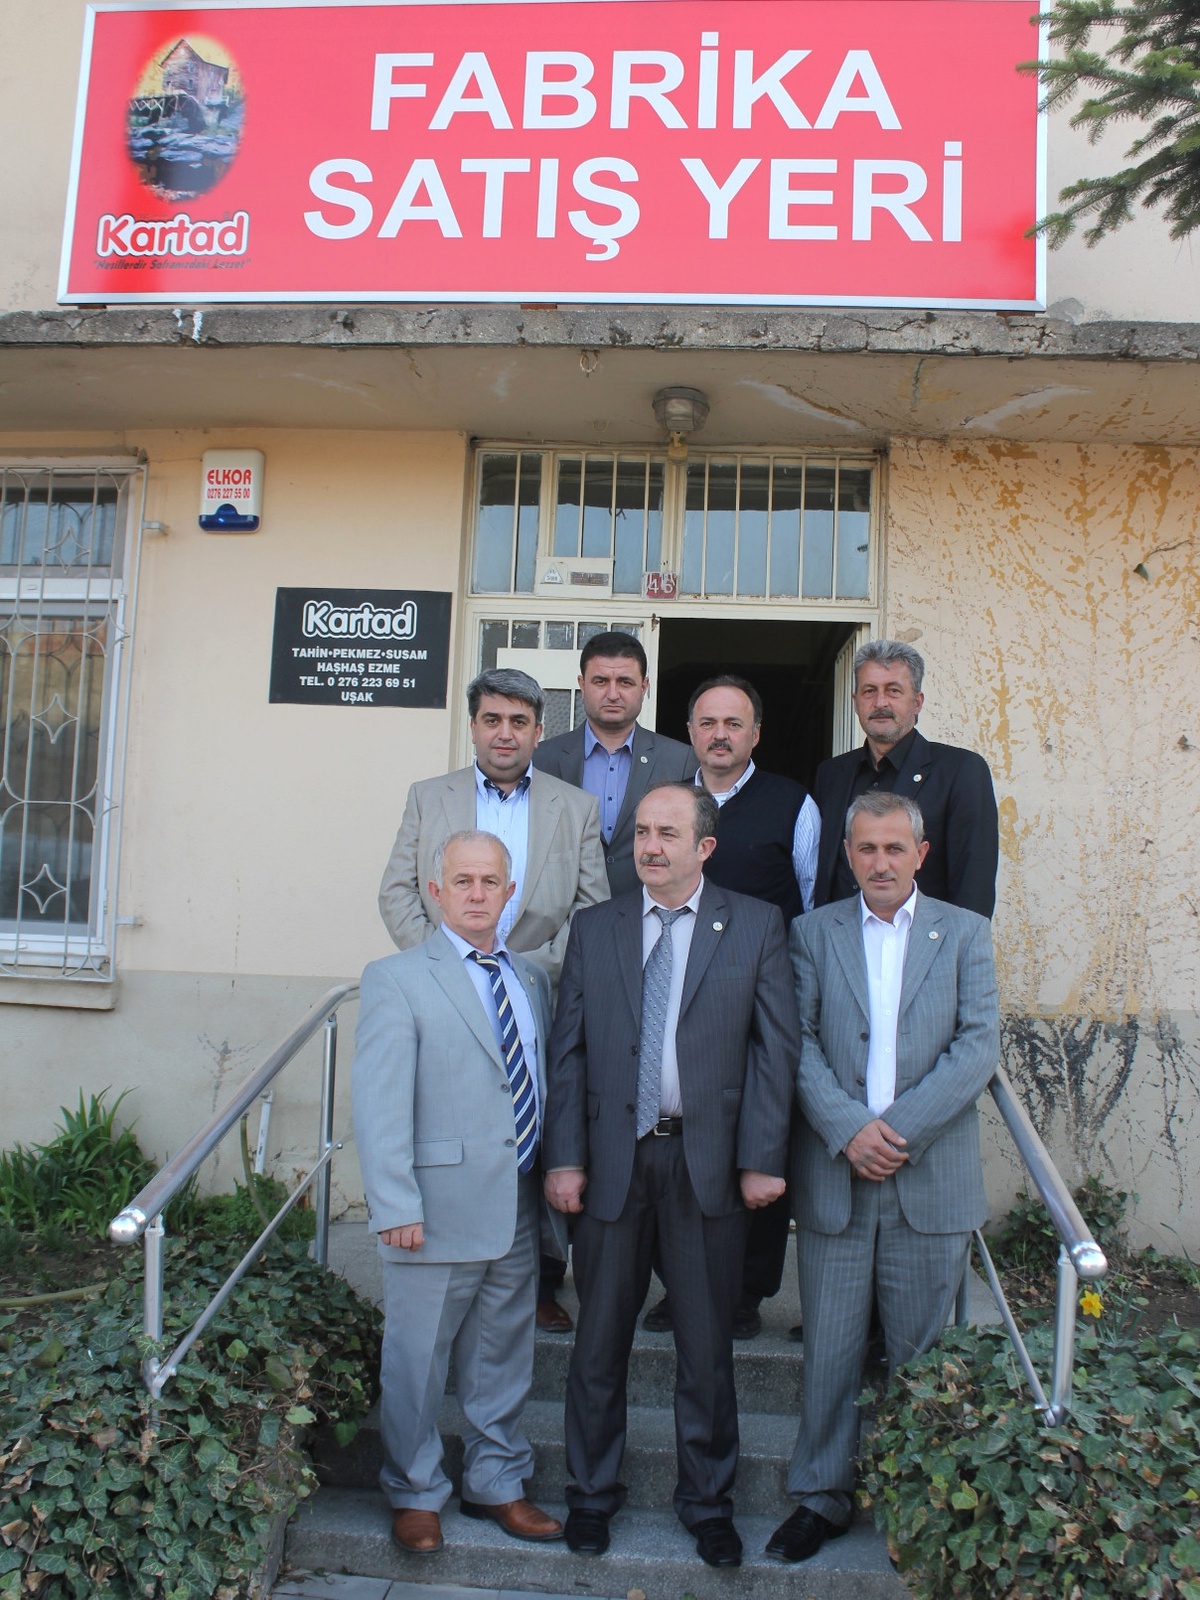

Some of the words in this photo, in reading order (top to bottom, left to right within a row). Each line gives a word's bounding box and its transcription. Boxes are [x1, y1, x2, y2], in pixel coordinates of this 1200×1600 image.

[371, 32, 902, 130] FABRİKA
[303, 157, 641, 262] SATIŞ
[680, 141, 963, 242] YERİ
[97, 211, 250, 257] Kartad
[207, 469, 252, 486] ELKOR
[222, 488, 233, 499] 227
[302, 600, 418, 640] Kartad
[317, 662, 365, 676] HAŞHAŞ
[368, 663, 401, 674] EZME
[300, 676, 325, 686] TEL.
[327, 677, 334, 687] 0
[338, 677, 359, 687] 276
[361, 678, 383, 688] 223
[385, 678, 400, 688] 69
[402, 678, 416, 688] 51
[341, 691, 374, 704] UŞAK
